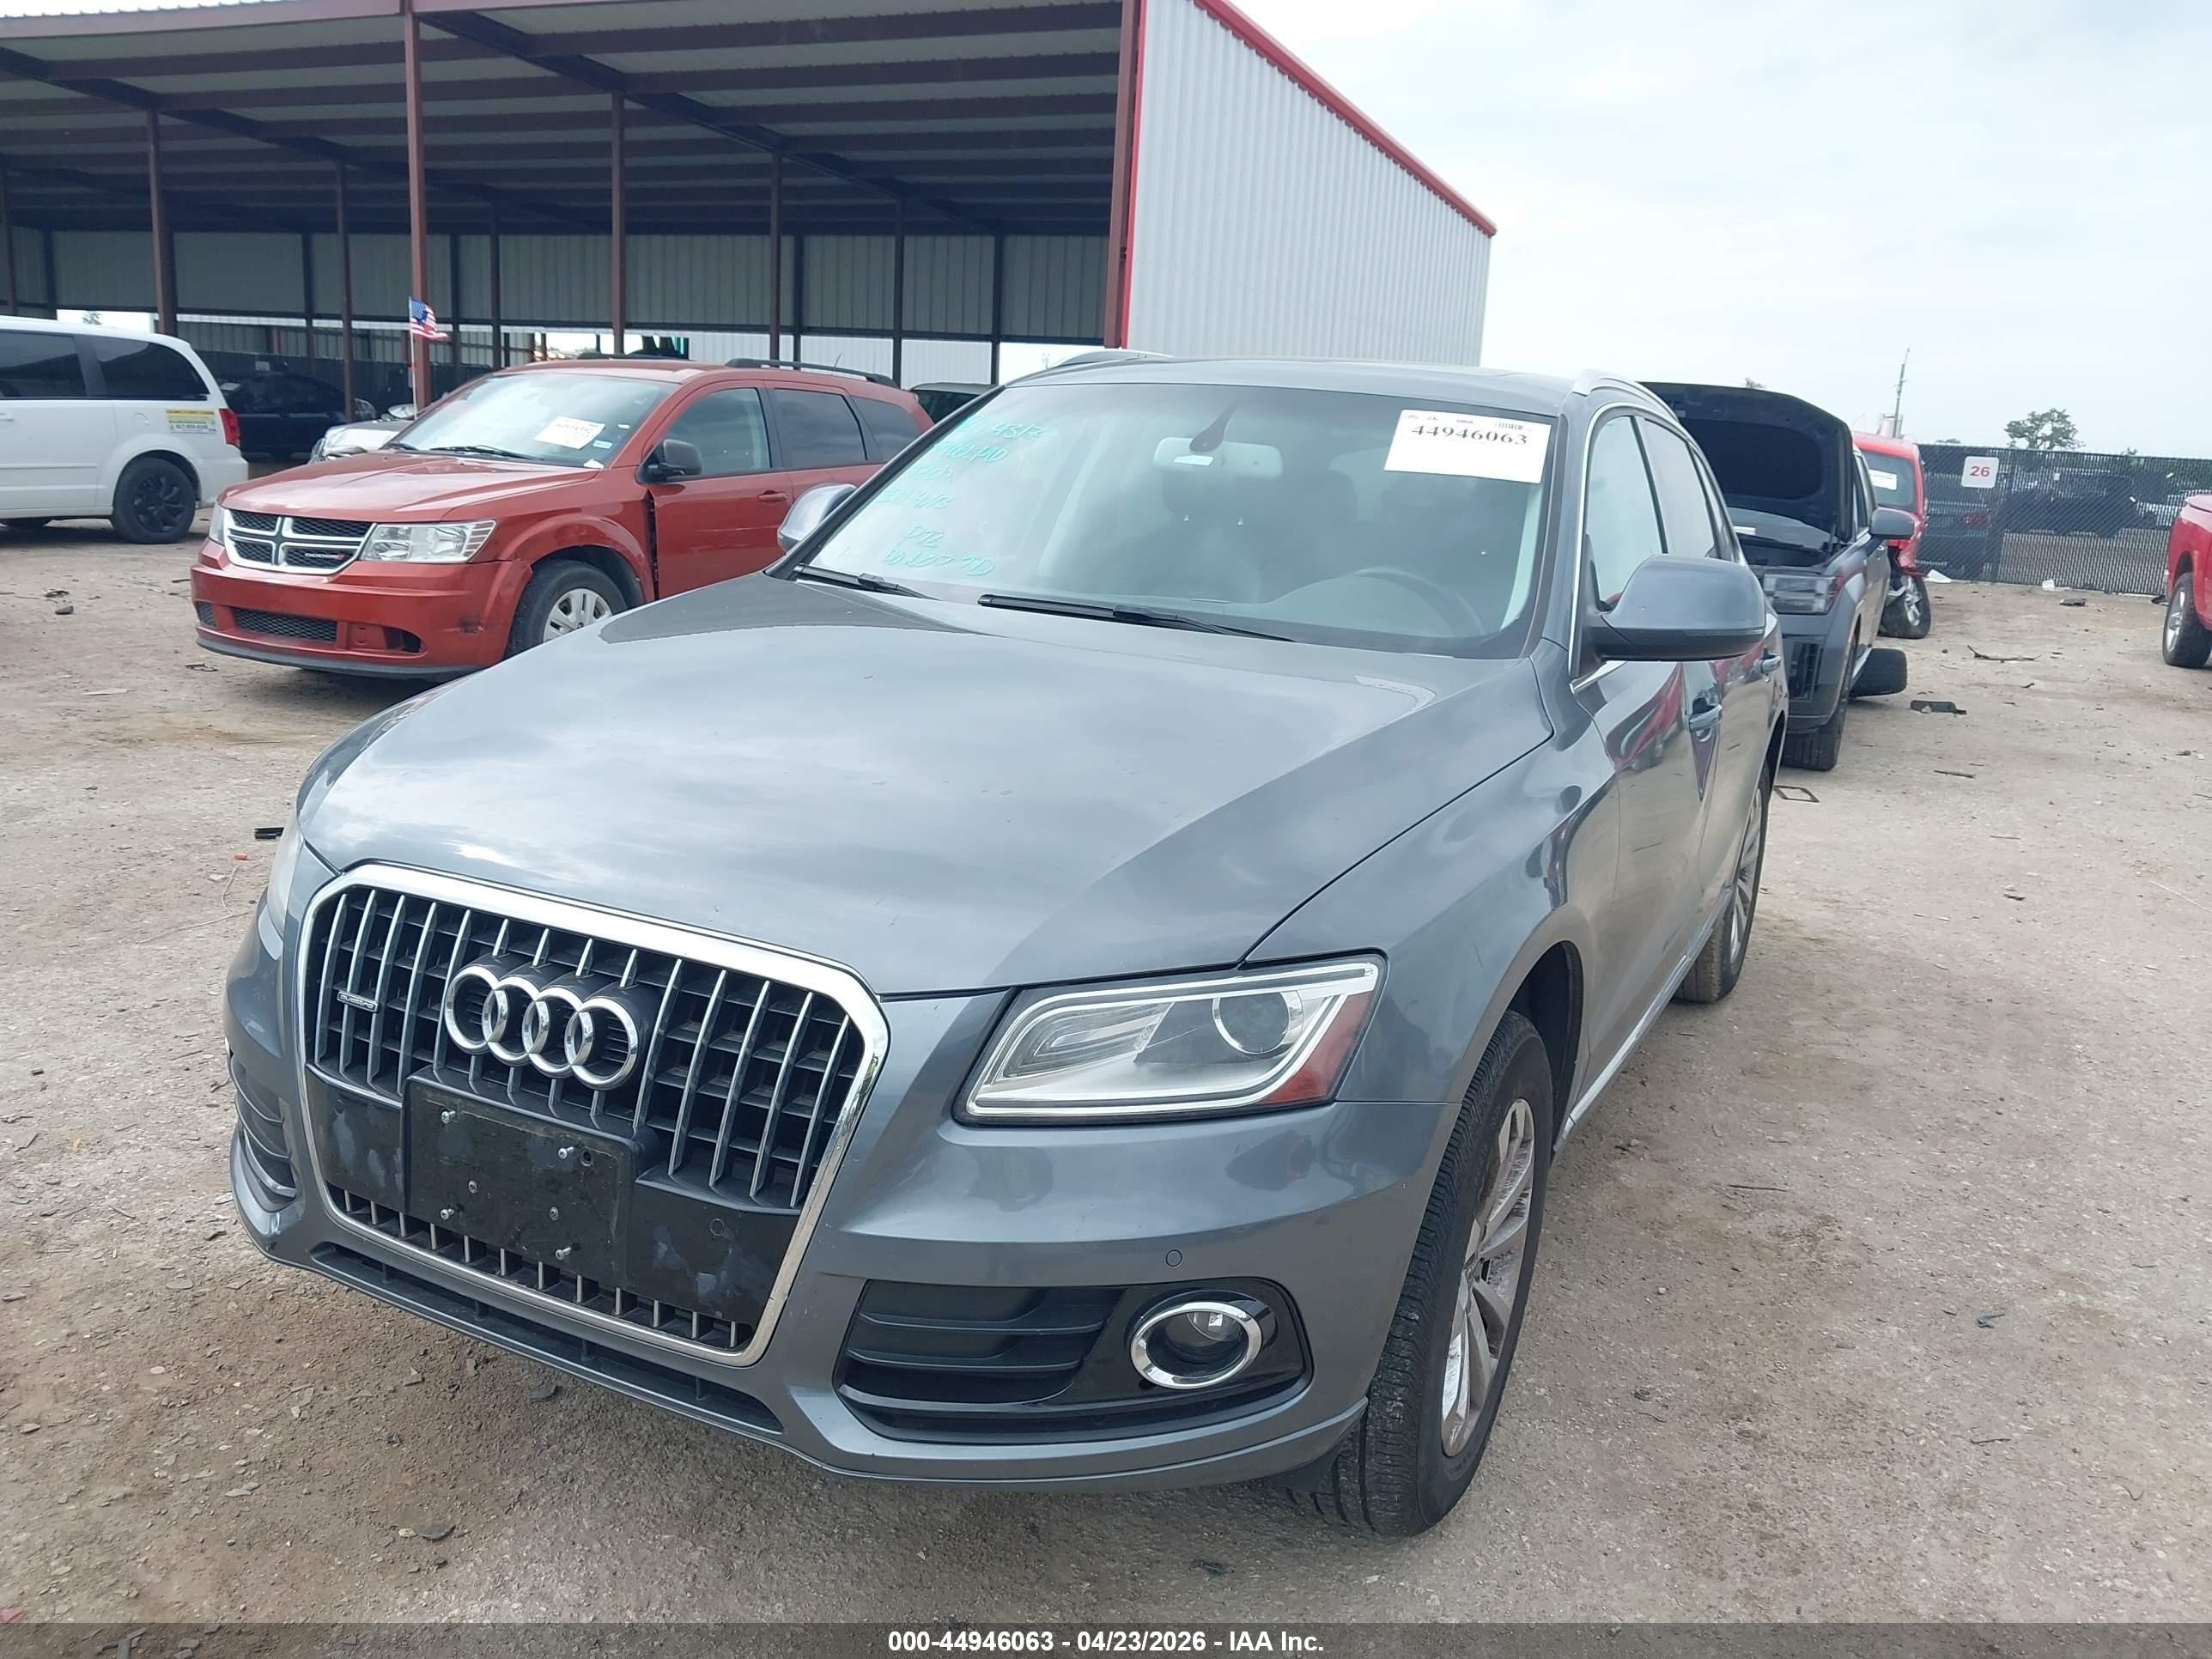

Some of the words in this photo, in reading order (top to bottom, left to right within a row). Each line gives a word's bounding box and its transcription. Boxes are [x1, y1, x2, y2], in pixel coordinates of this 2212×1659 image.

[1412, 425, 1528, 445] 44946063
[1969, 465, 1991, 477] 26
[338, 994, 374, 1010] quattro
